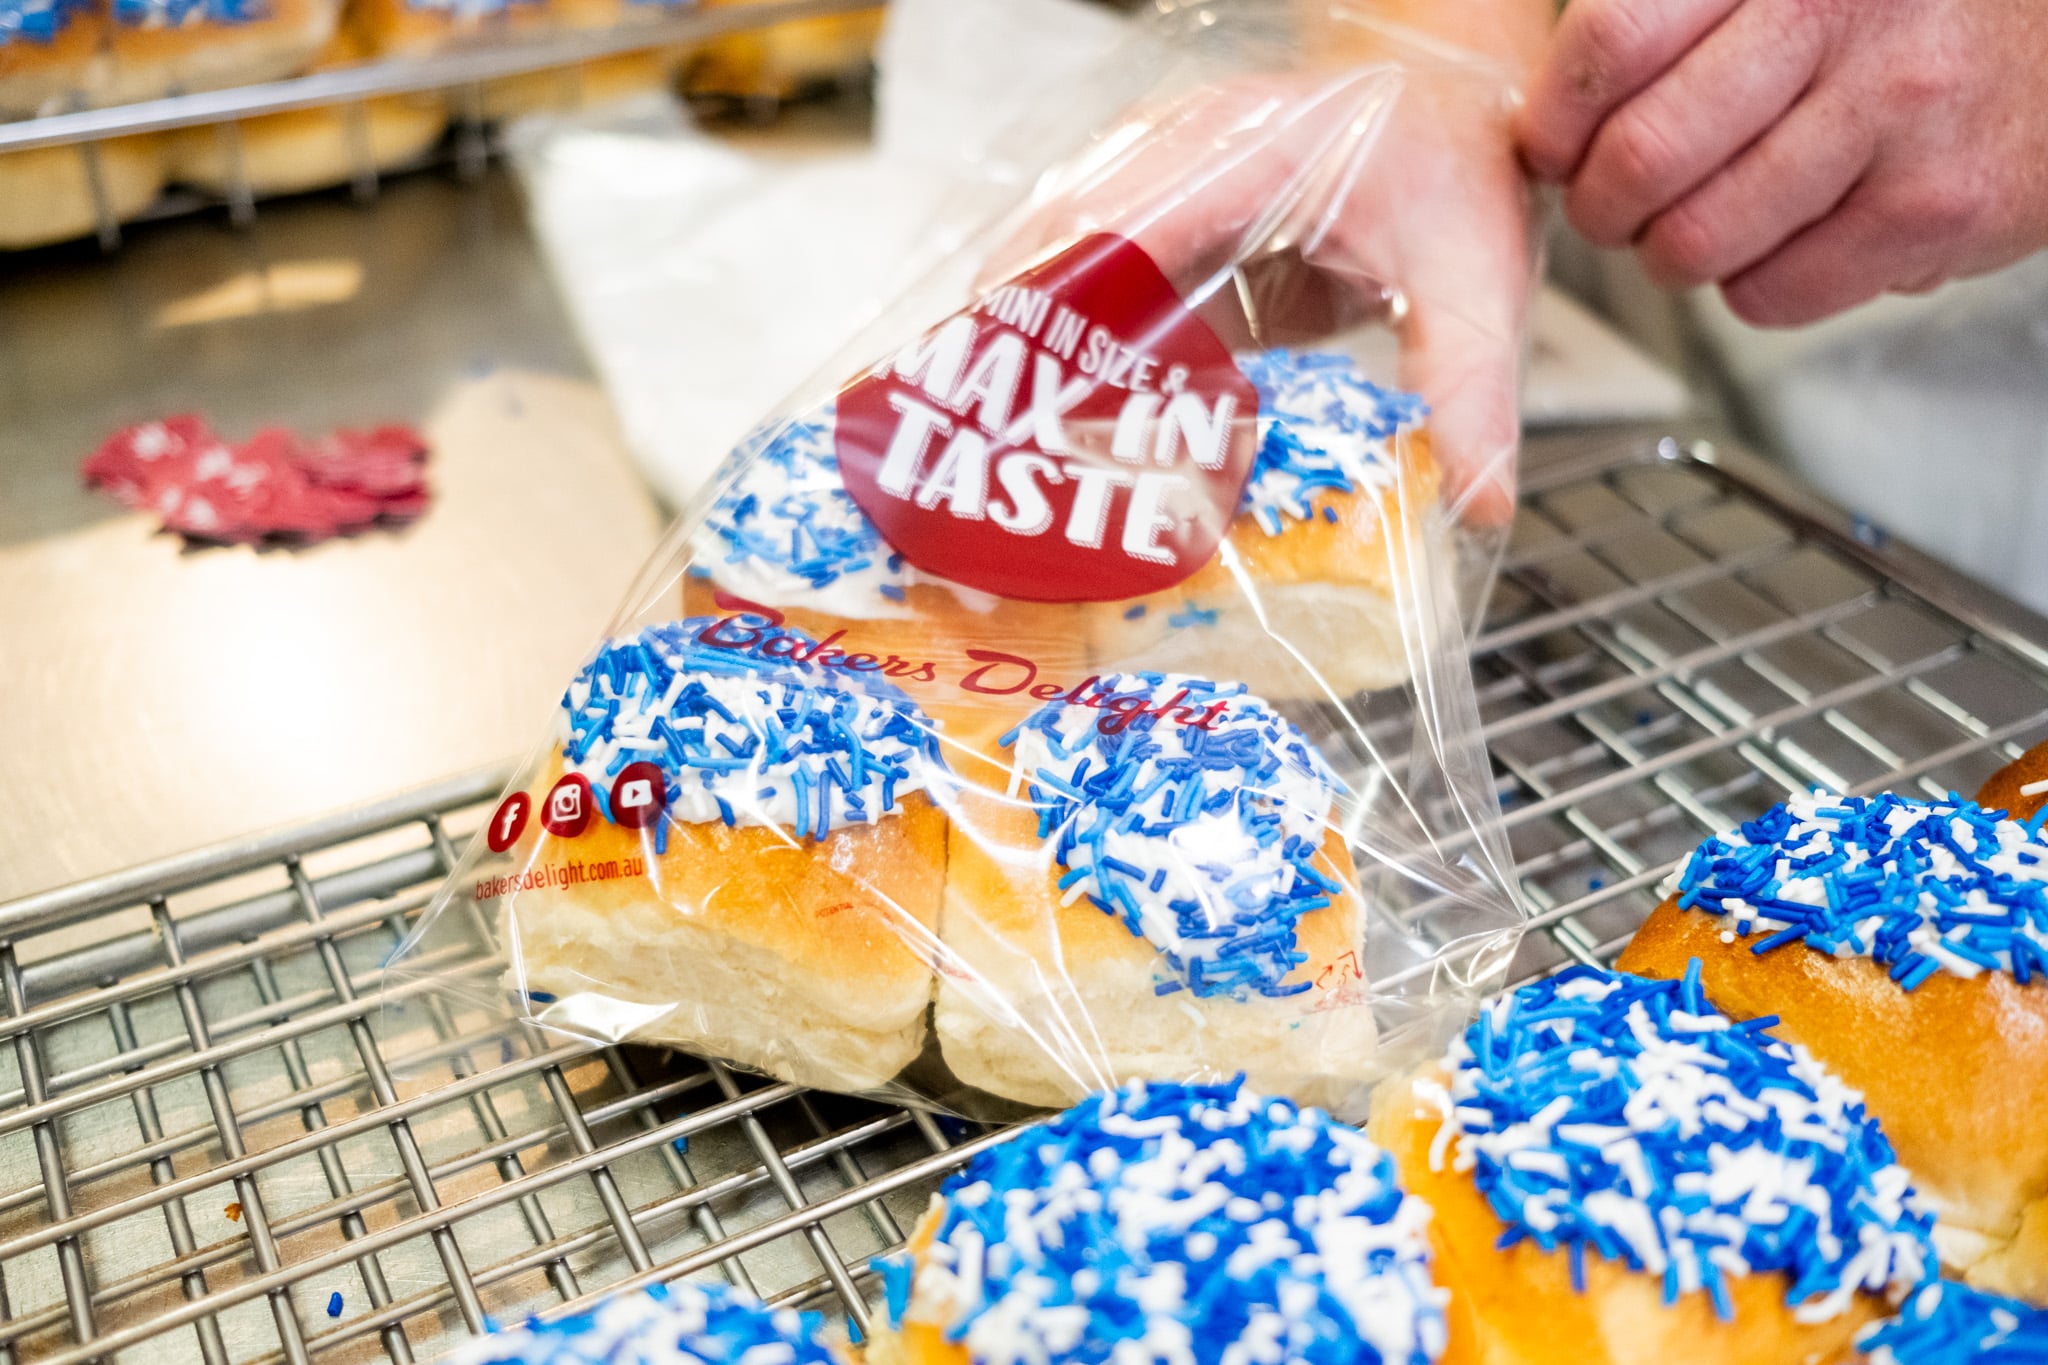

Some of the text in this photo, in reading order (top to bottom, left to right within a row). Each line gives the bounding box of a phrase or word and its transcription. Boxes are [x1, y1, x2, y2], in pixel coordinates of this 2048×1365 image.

[872, 316, 1238, 471] MAX IN
[1043, 306, 1089, 361] IN
[1078, 328, 1160, 393] SIZE
[1160, 365, 1189, 395] &
[876, 391, 1192, 567] TASTE
[697, 591, 1232, 736] Bakers Delight
[475, 856, 643, 902] bakersdelight.com.au
